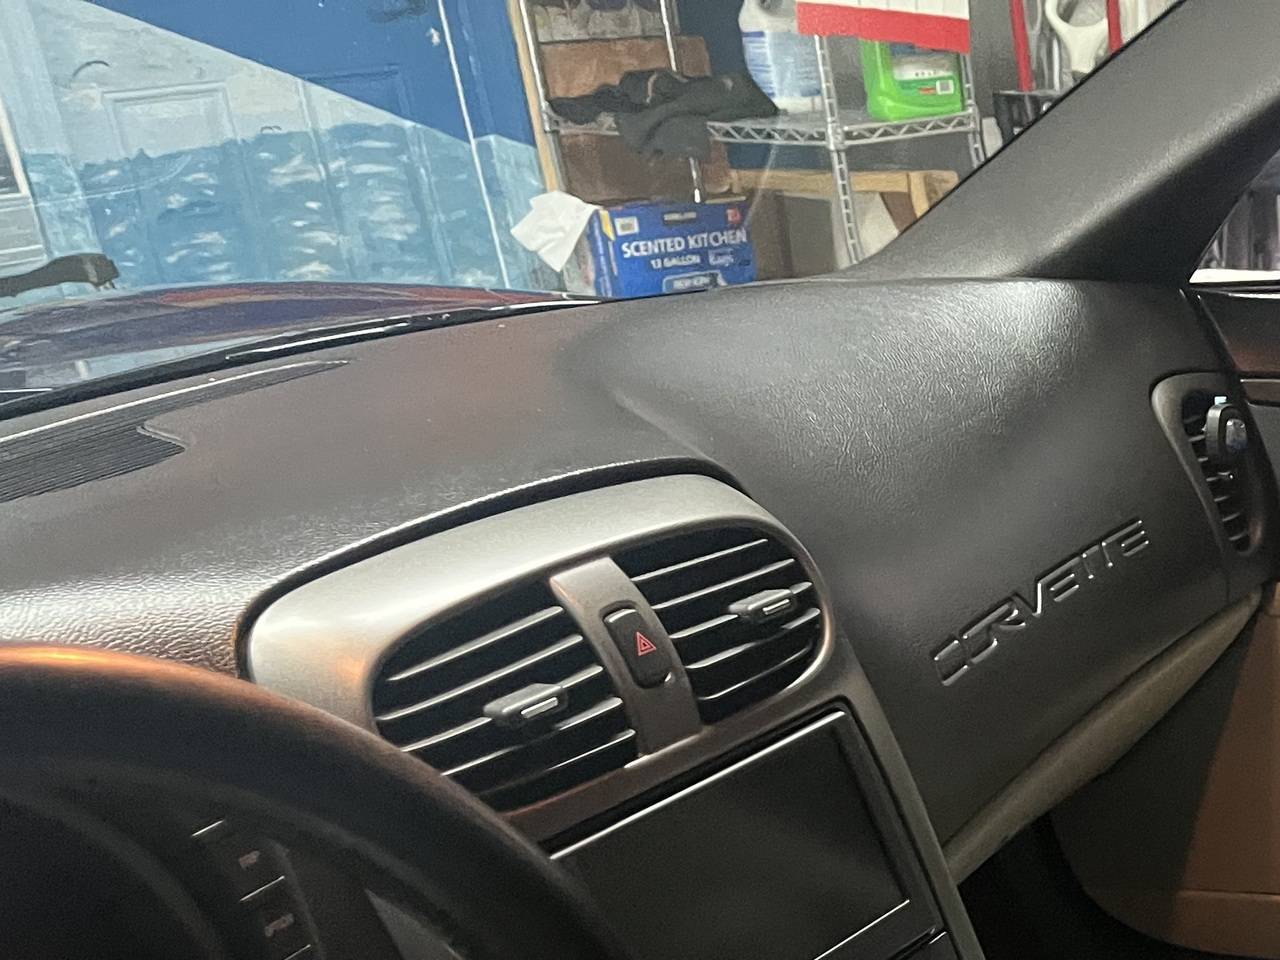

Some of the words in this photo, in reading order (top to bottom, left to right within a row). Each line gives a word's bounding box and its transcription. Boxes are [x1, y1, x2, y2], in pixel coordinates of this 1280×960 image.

[621, 237, 685, 258] SCENTED
[687, 228, 747, 249] KITCHEN
[663, 255, 701, 268] GALLON
[933, 517, 1150, 686] CORVETTE
